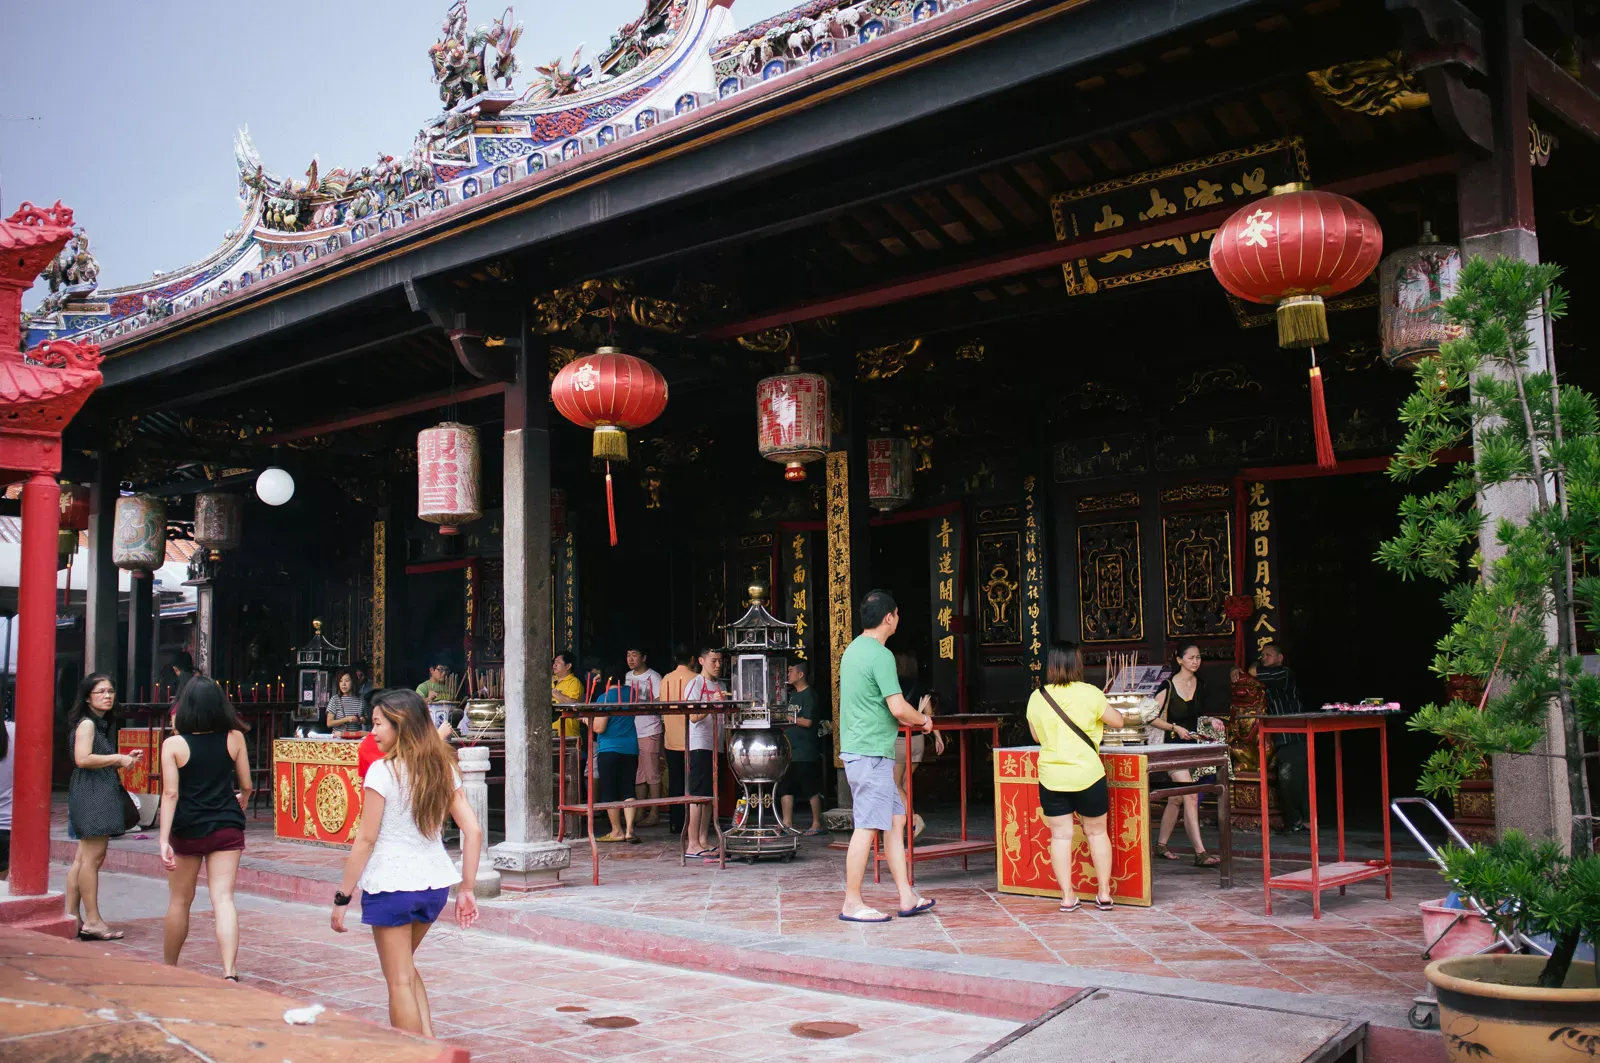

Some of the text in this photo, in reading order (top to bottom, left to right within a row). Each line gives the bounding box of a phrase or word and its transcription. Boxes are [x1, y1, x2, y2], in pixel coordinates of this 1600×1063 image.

[1239, 208, 1273, 248] 安
[572, 363, 600, 391] 意
[936, 518, 955, 660] 青蓮開佛國
[1002, 753, 1019, 776] 安
[1118, 757, 1136, 779] 道
